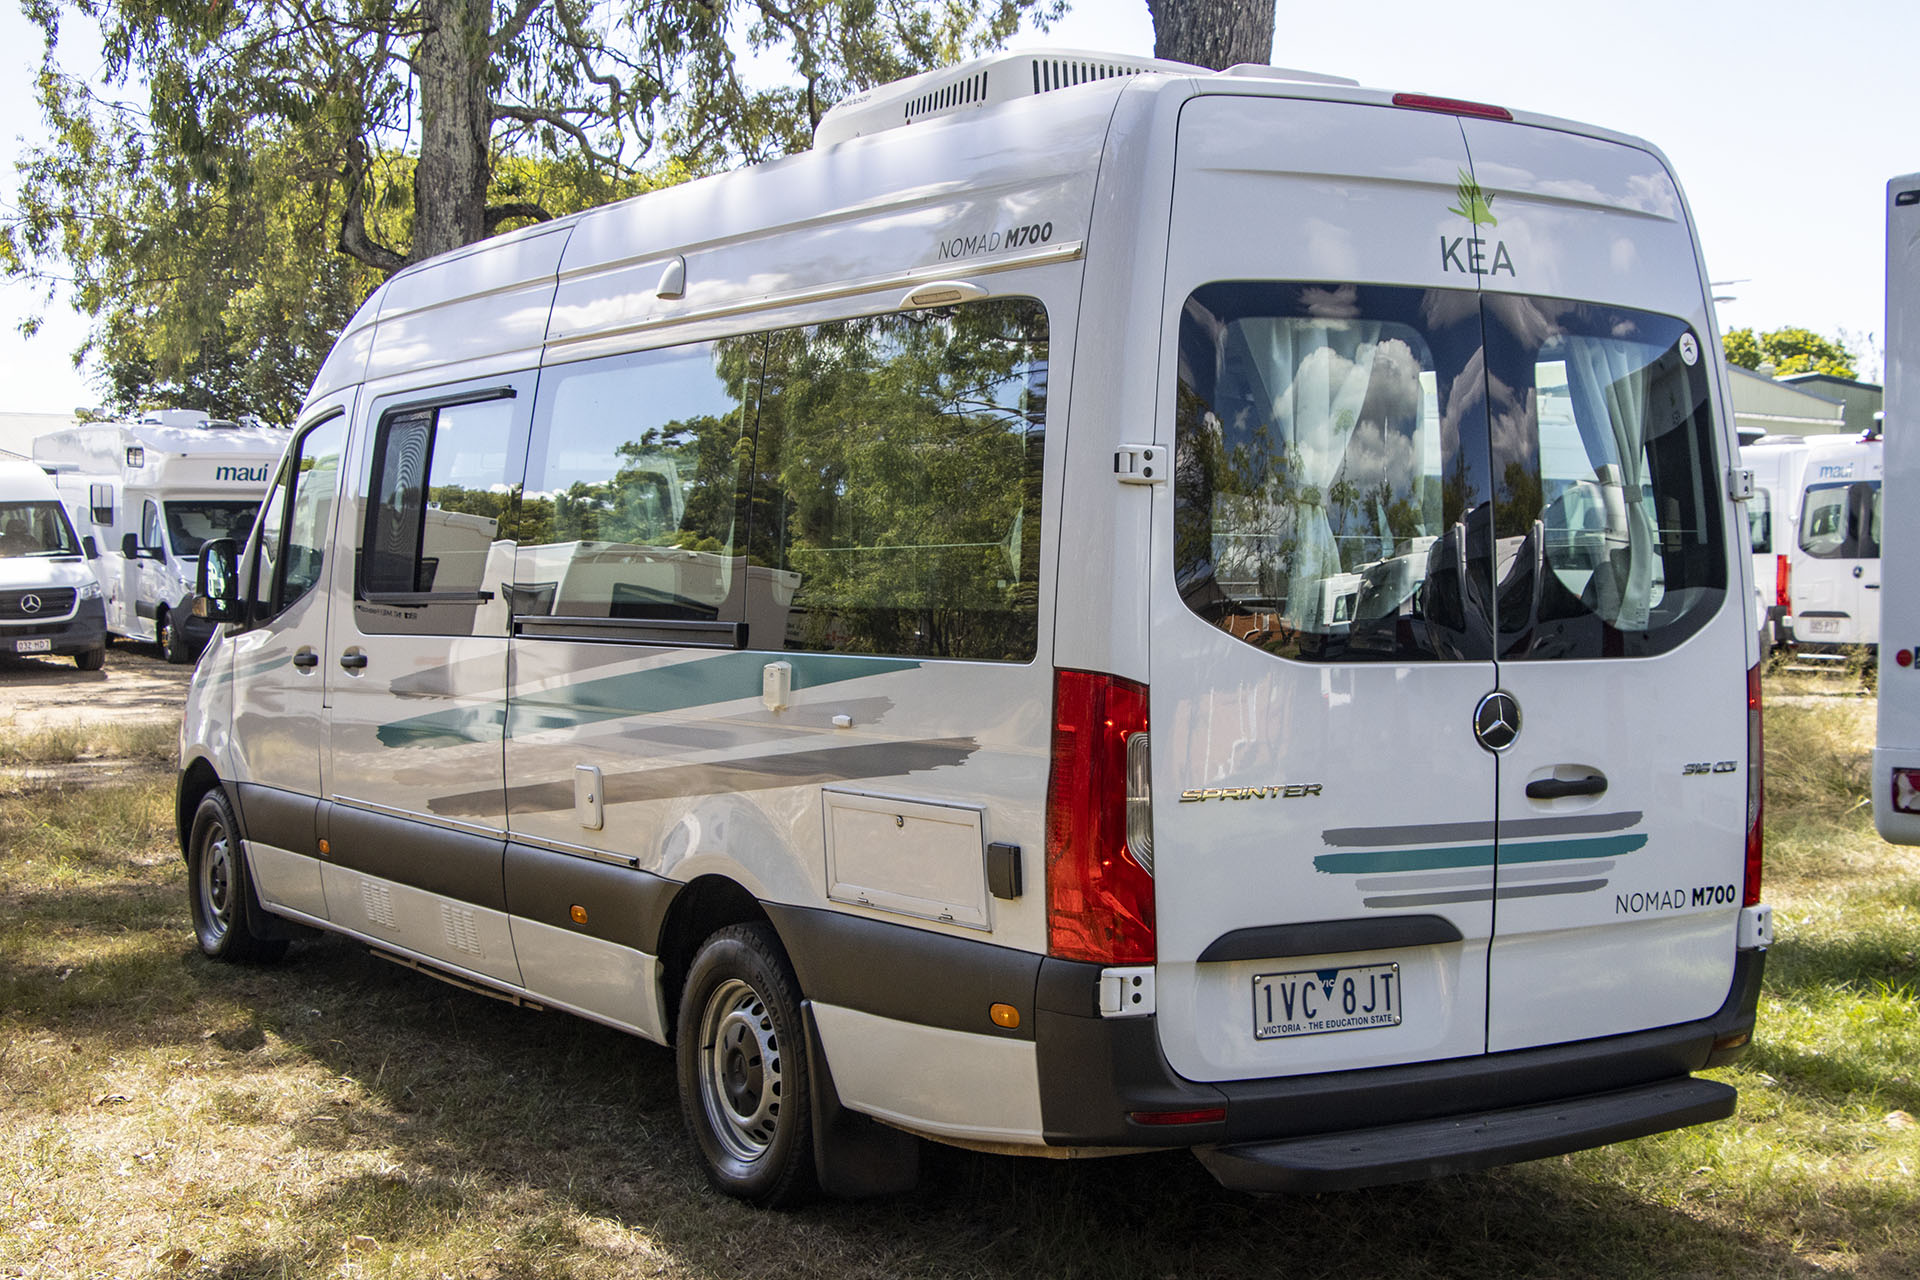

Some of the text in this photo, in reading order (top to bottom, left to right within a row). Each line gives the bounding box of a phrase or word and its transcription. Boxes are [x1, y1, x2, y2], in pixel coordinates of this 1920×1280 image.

[938, 221, 1053, 260] NOMAD M700
[1440, 235, 1516, 277] KEA
[216, 463, 269, 482] maui
[1820, 462, 1854, 478] maui
[1179, 783, 1323, 804] SPRINTER
[1615, 884, 1736, 914] NOMAD M700
[1263, 973, 1394, 1023] 1VC 8JT
[1263, 1023, 1301, 1035] VICTORIA
[1308, 1020, 1324, 1030] THE
[1325, 1016, 1368, 1029] EDUCATION
[1370, 1013, 1393, 1025] STATE
